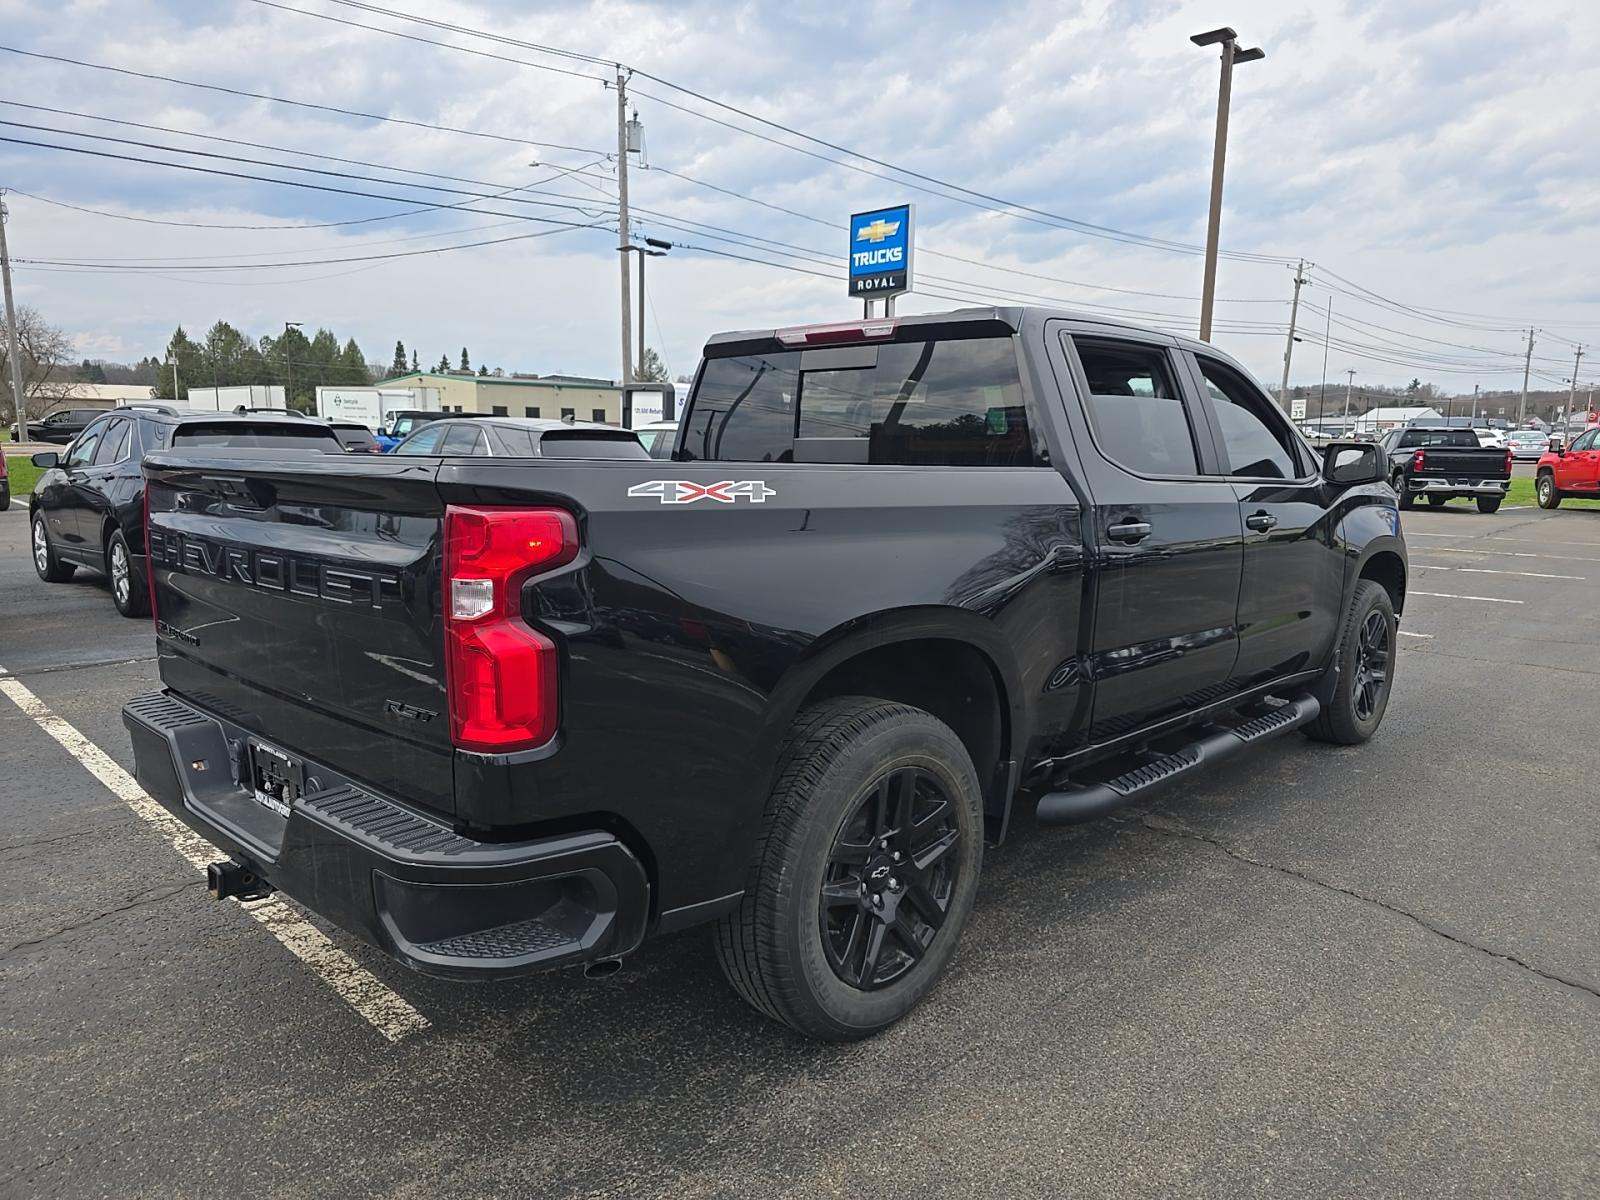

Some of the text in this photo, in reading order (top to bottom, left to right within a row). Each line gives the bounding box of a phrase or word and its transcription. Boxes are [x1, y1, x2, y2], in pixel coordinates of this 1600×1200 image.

[853, 247, 902, 266] TRUCKS
[858, 277, 896, 290] ROYAL
[149, 530, 398, 609] CHEVROLET
